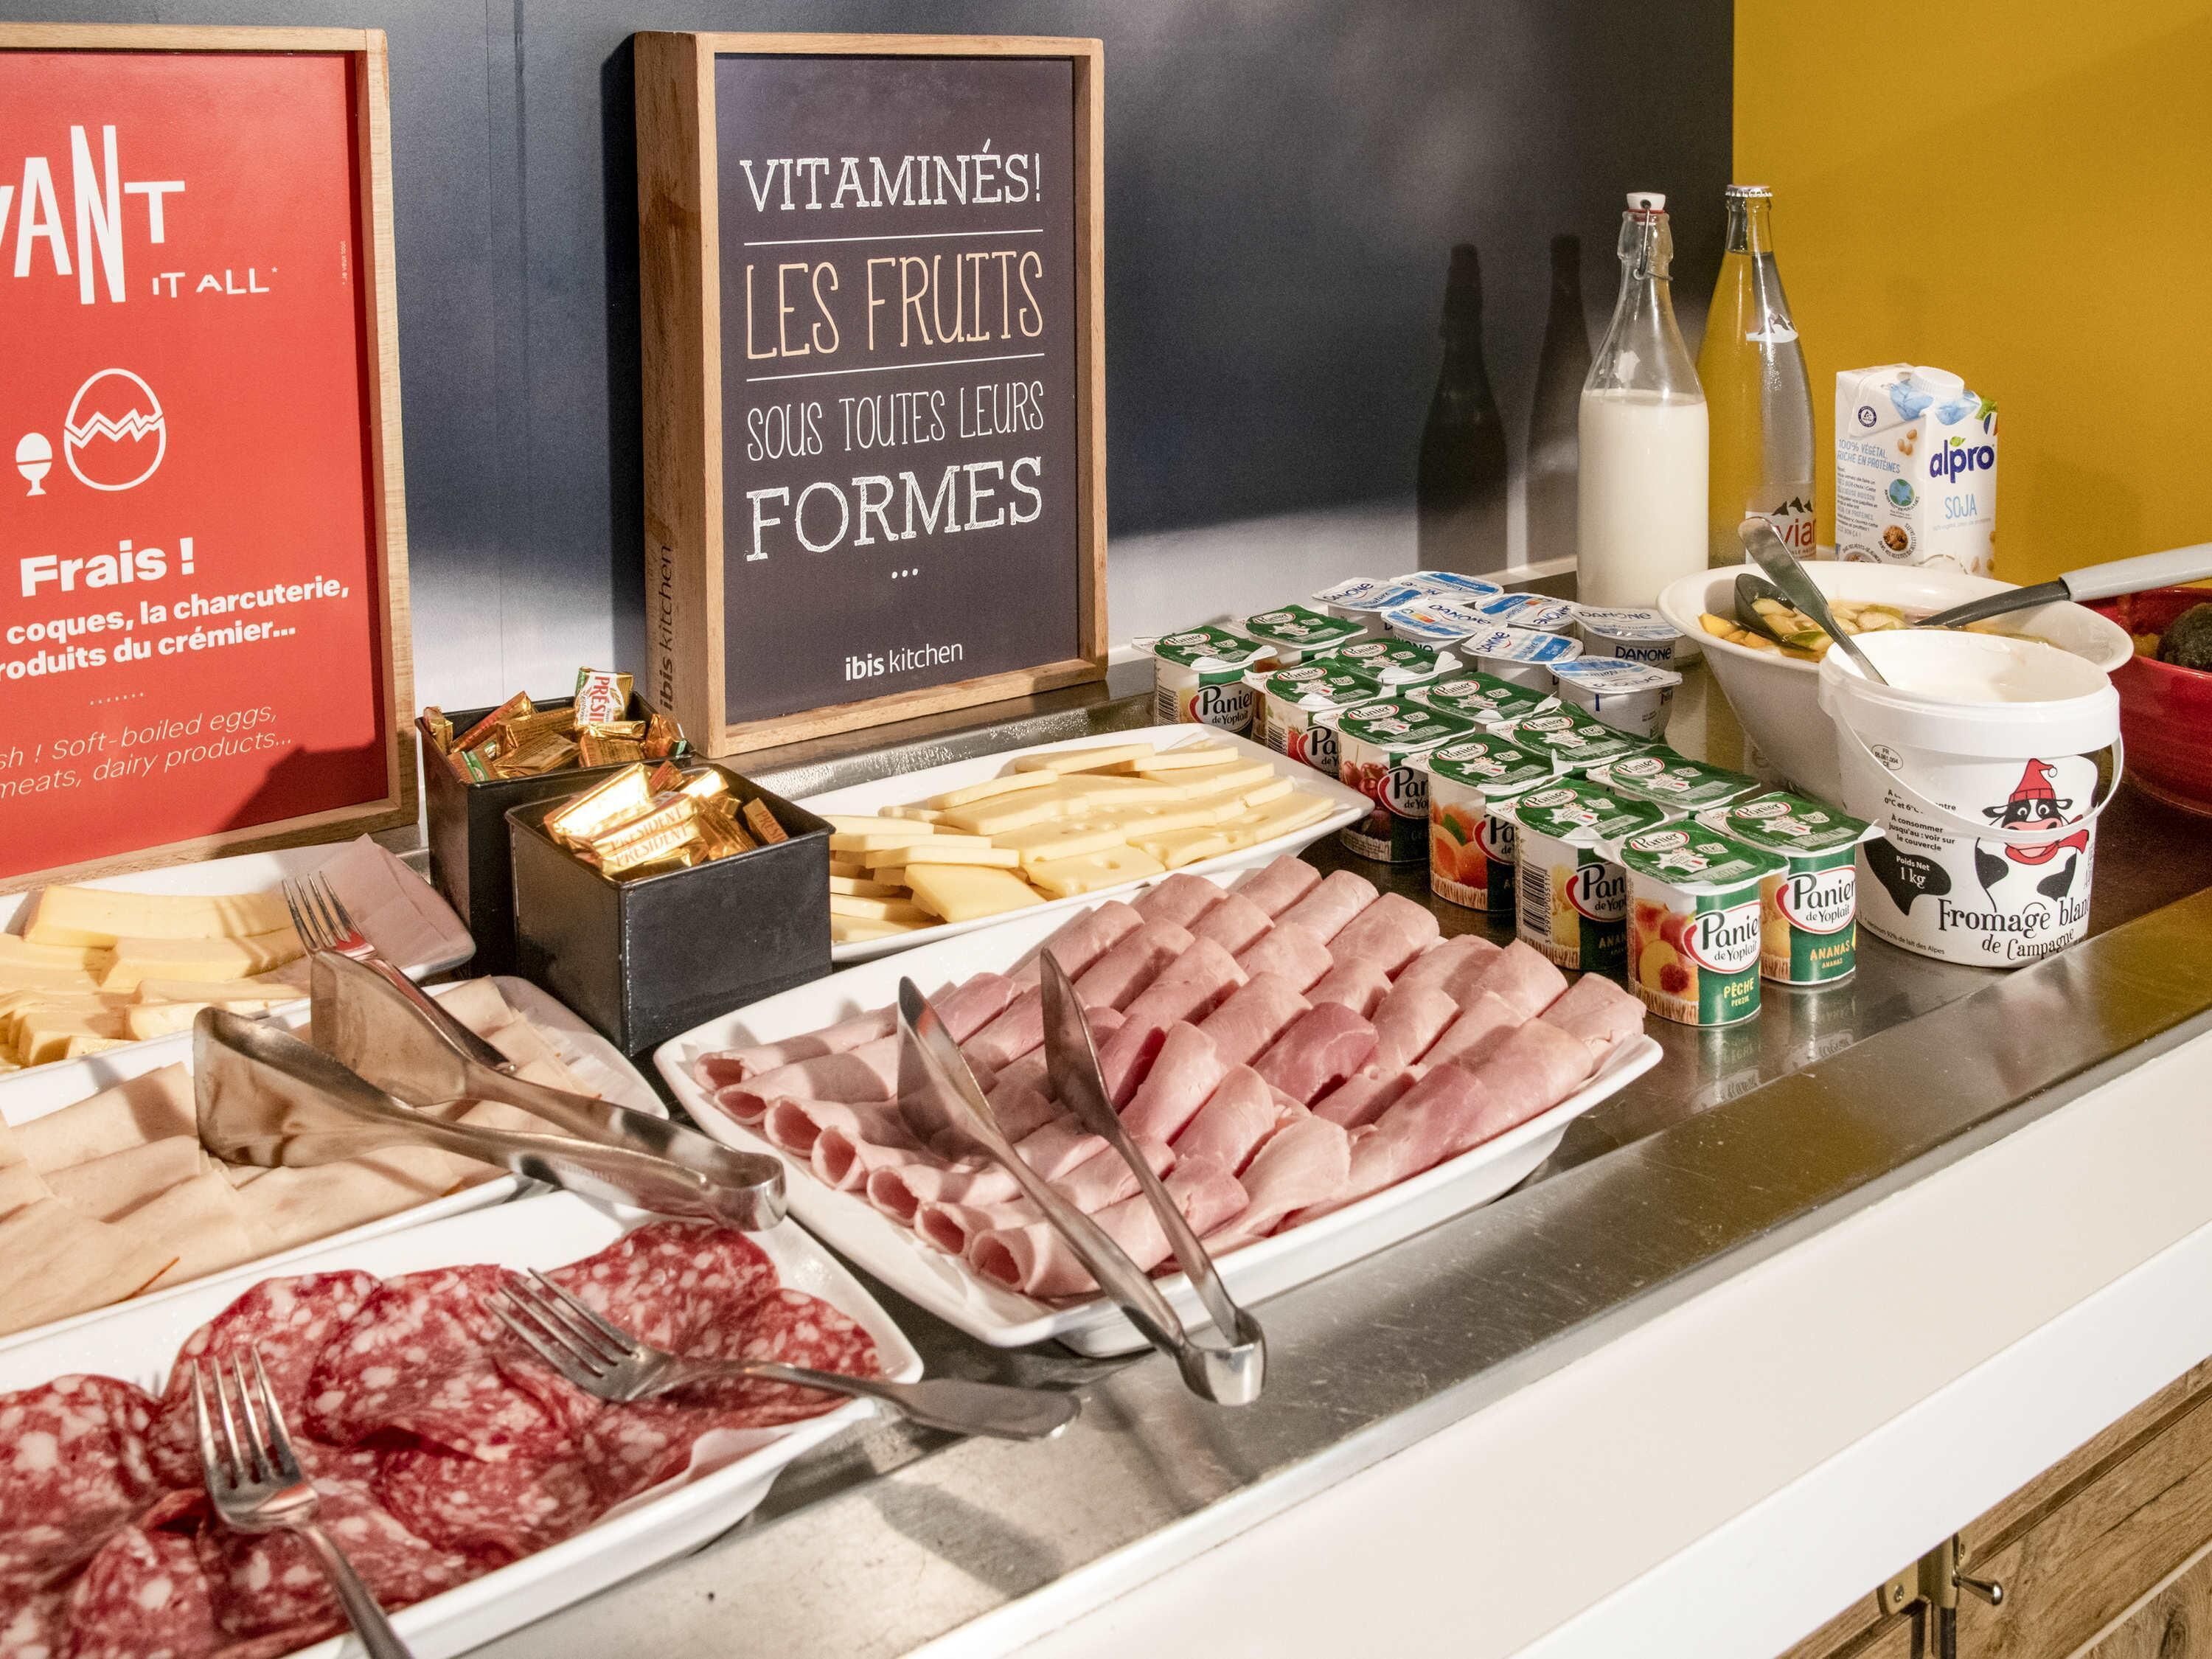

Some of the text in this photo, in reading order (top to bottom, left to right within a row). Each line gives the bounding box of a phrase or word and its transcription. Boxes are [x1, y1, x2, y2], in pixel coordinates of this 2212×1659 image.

[740, 139, 1040, 212] VITAMINÉS!
[153, 272, 185, 298] IT
[746, 251, 1043, 359] LES FRUITS
[747, 380, 1043, 461] SOUS TOUTES LEURS
[1930, 439, 1994, 484] alpro
[746, 456, 1042, 561] FORMES
[1945, 494, 1978, 519] SOJA
[1774, 518, 1816, 547] via
[20, 537, 195, 597] Frais !
[6, 575, 349, 645] coques, la charcuterie,
[114, 638, 151, 663] du
[158, 619, 296, 655] crémier...
[658, 546, 672, 711] ibis kitchen
[846, 643, 963, 681] ibis kitchen
[1615, 644, 1672, 661] DANONE
[590, 675, 611, 723] PRÉSI
[1212, 710, 1248, 726] de Yoplait
[1352, 706, 1391, 718] Panier
[52, 713, 203, 760] Soft-boiled
[210, 705, 277, 737] eggs,
[94, 748, 156, 782] dairy
[164, 733, 292, 773] products...
[1440, 744, 1478, 758] Panier
[1388, 768, 1428, 799] Pan
[1527, 790, 1568, 806] Panier
[1739, 803, 1781, 816] Panier
[1898, 801, 1905, 809] et
[1935, 802, 1956, 810] ntre
[1898, 817, 1943, 833] consommer
[1924, 832, 1940, 842] voir
[1635, 832, 1680, 849] Panier
[1896, 834, 1942, 852] le couvercle
[1896, 855, 1930, 872] Poids Net
[1576, 863, 1625, 900] Pan
[1900, 866, 1926, 889] 1 kg
[1787, 874, 1855, 910] Panier
[1595, 901, 1606, 911] de
[1806, 904, 1850, 923] de Yoplait
[1938, 894, 2089, 939] Fromage blan
[1694, 910, 1760, 950] Panie
[1714, 941, 1758, 961] de Yoplait
[1810, 940, 1850, 961] ANANAS
[1928, 945, 1944, 955] Alpes
[1982, 928, 2074, 960] de Campagne
[1724, 977, 1754, 998] PÊCHE
